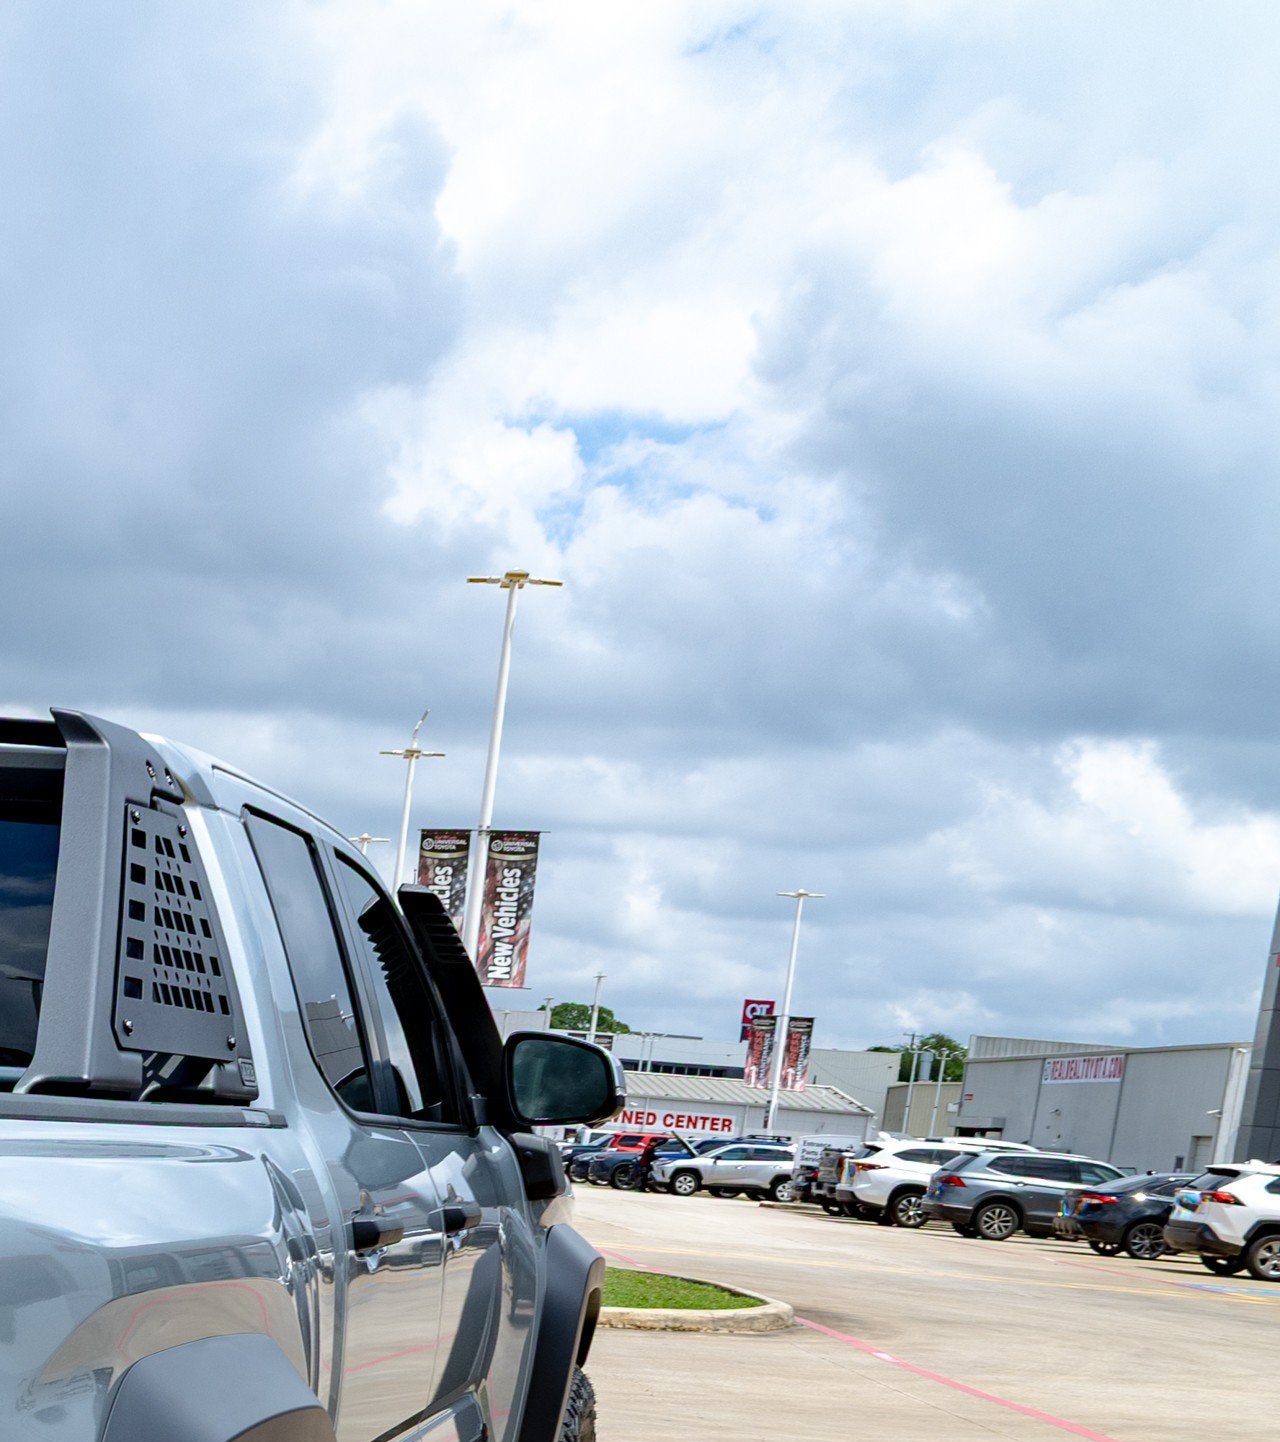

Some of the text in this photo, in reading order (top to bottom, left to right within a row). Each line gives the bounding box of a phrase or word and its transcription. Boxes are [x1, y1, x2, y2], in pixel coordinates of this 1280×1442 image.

[492, 867, 522, 940] Vehicles
[488, 938, 514, 979] New
[612, 1110, 733, 1132] NED CENTER
